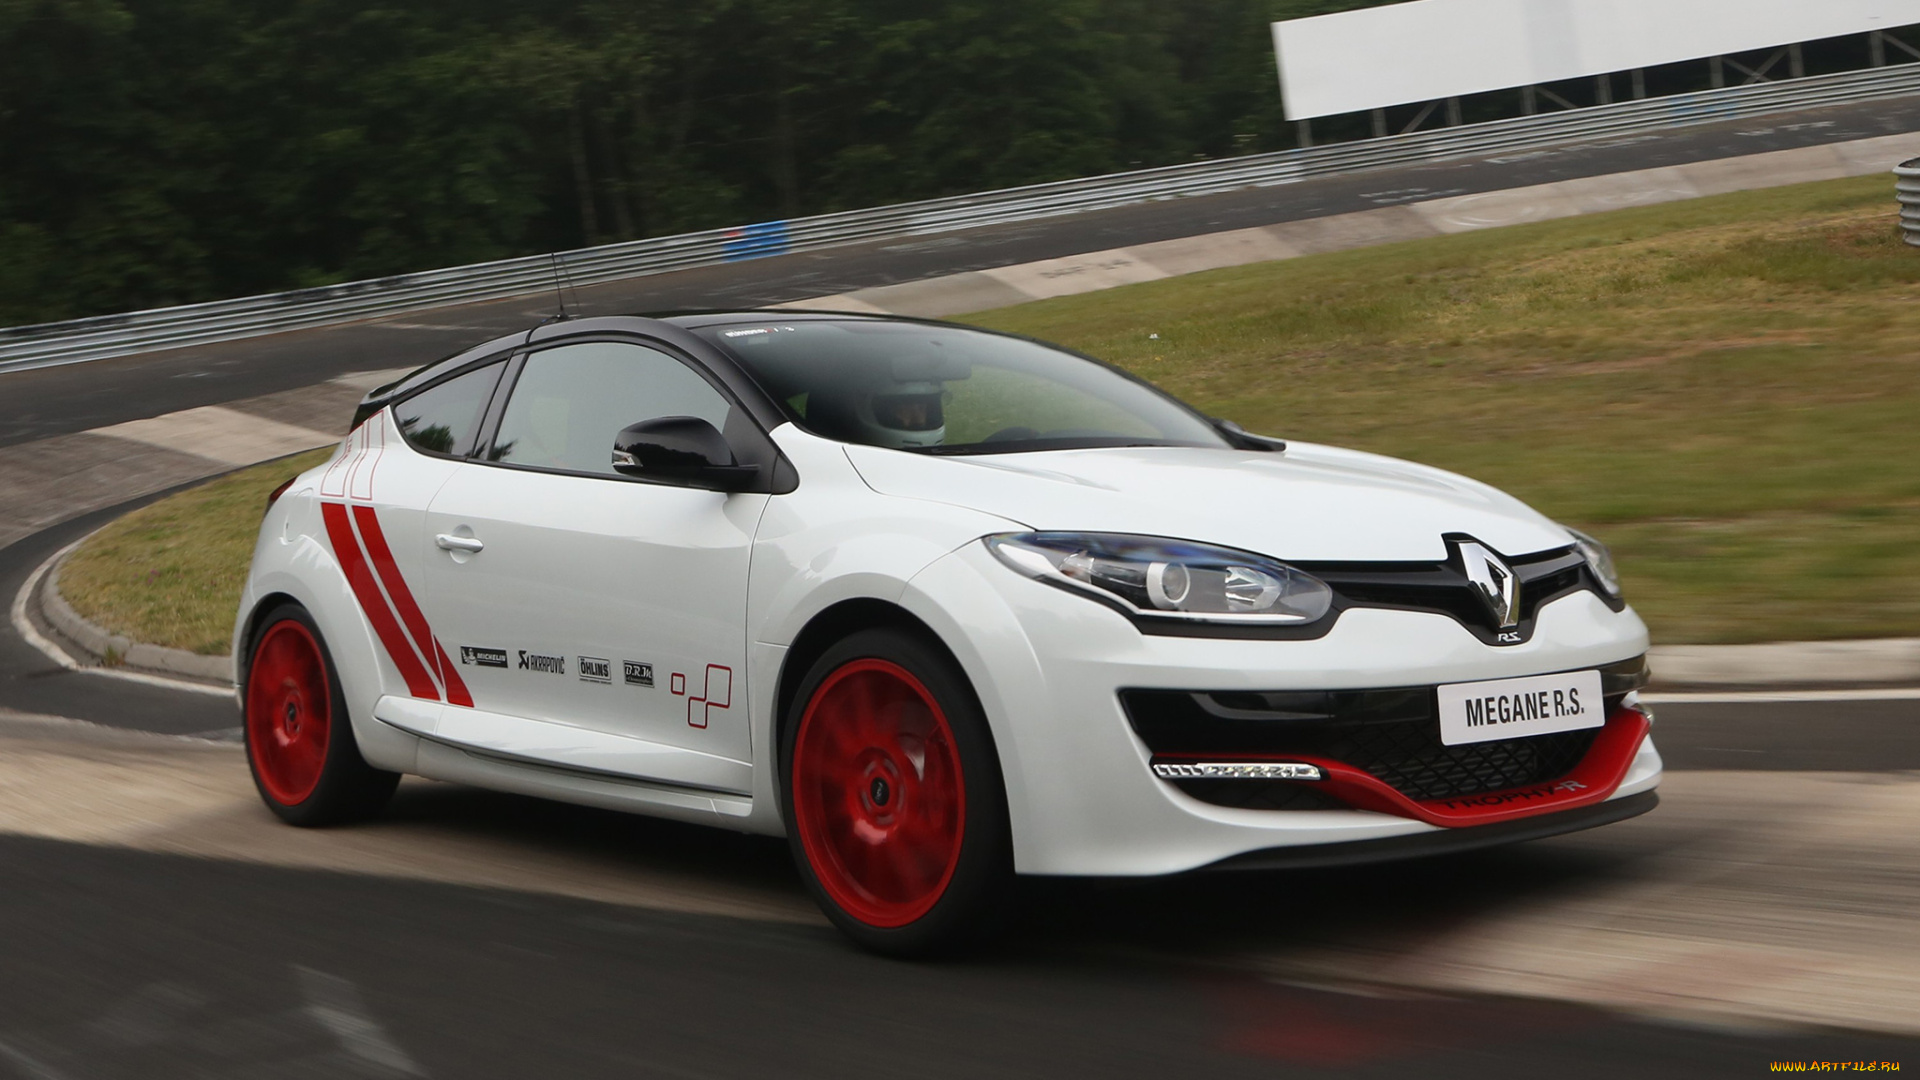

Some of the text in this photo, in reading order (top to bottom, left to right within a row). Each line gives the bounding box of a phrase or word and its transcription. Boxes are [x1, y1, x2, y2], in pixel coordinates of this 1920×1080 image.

[476, 652, 506, 662] MICHELIN
[580, 658, 609, 677] ÖHLINS
[1465, 687, 1585, 728] MEGANE R.S.
[1442, 780, 1587, 809] TROPHY-R
